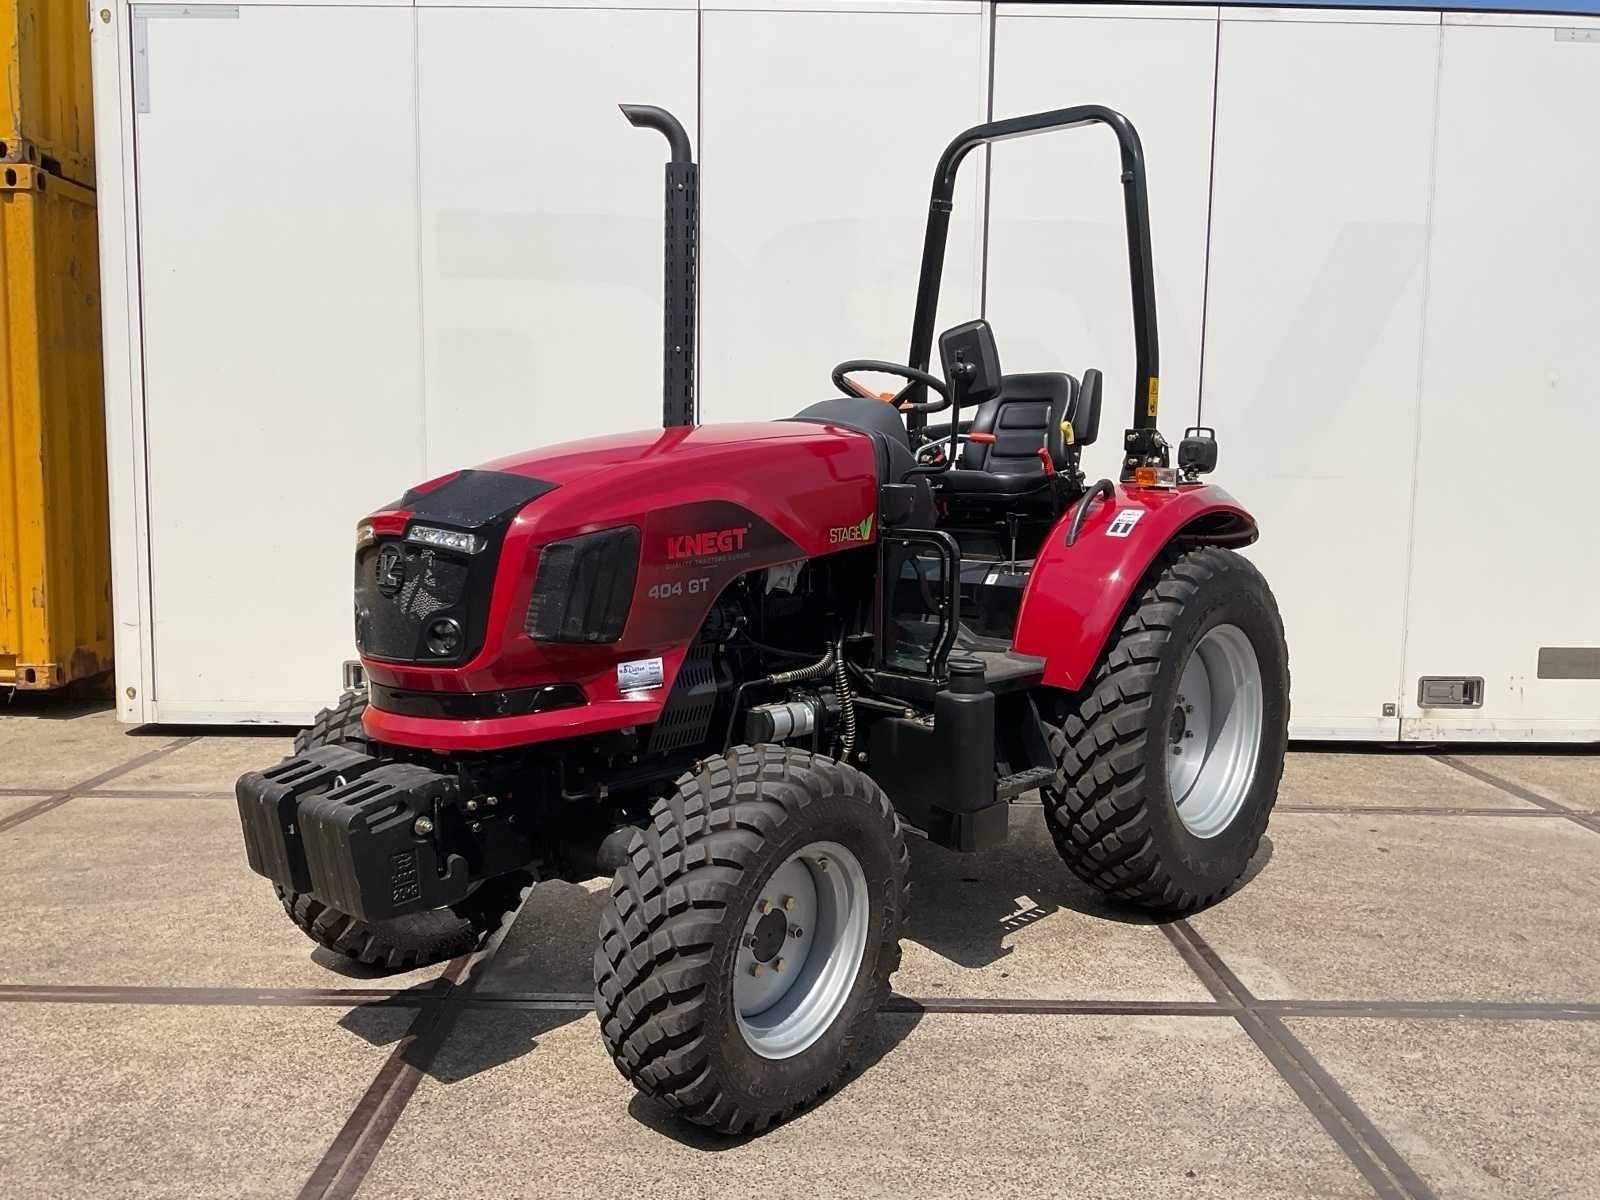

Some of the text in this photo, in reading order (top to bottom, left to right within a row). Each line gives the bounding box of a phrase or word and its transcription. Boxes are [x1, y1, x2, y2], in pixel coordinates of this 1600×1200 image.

[667, 527, 748, 559] KNEGT
[829, 526, 862, 543] STAGE
[648, 578, 710, 599] 404 GT
